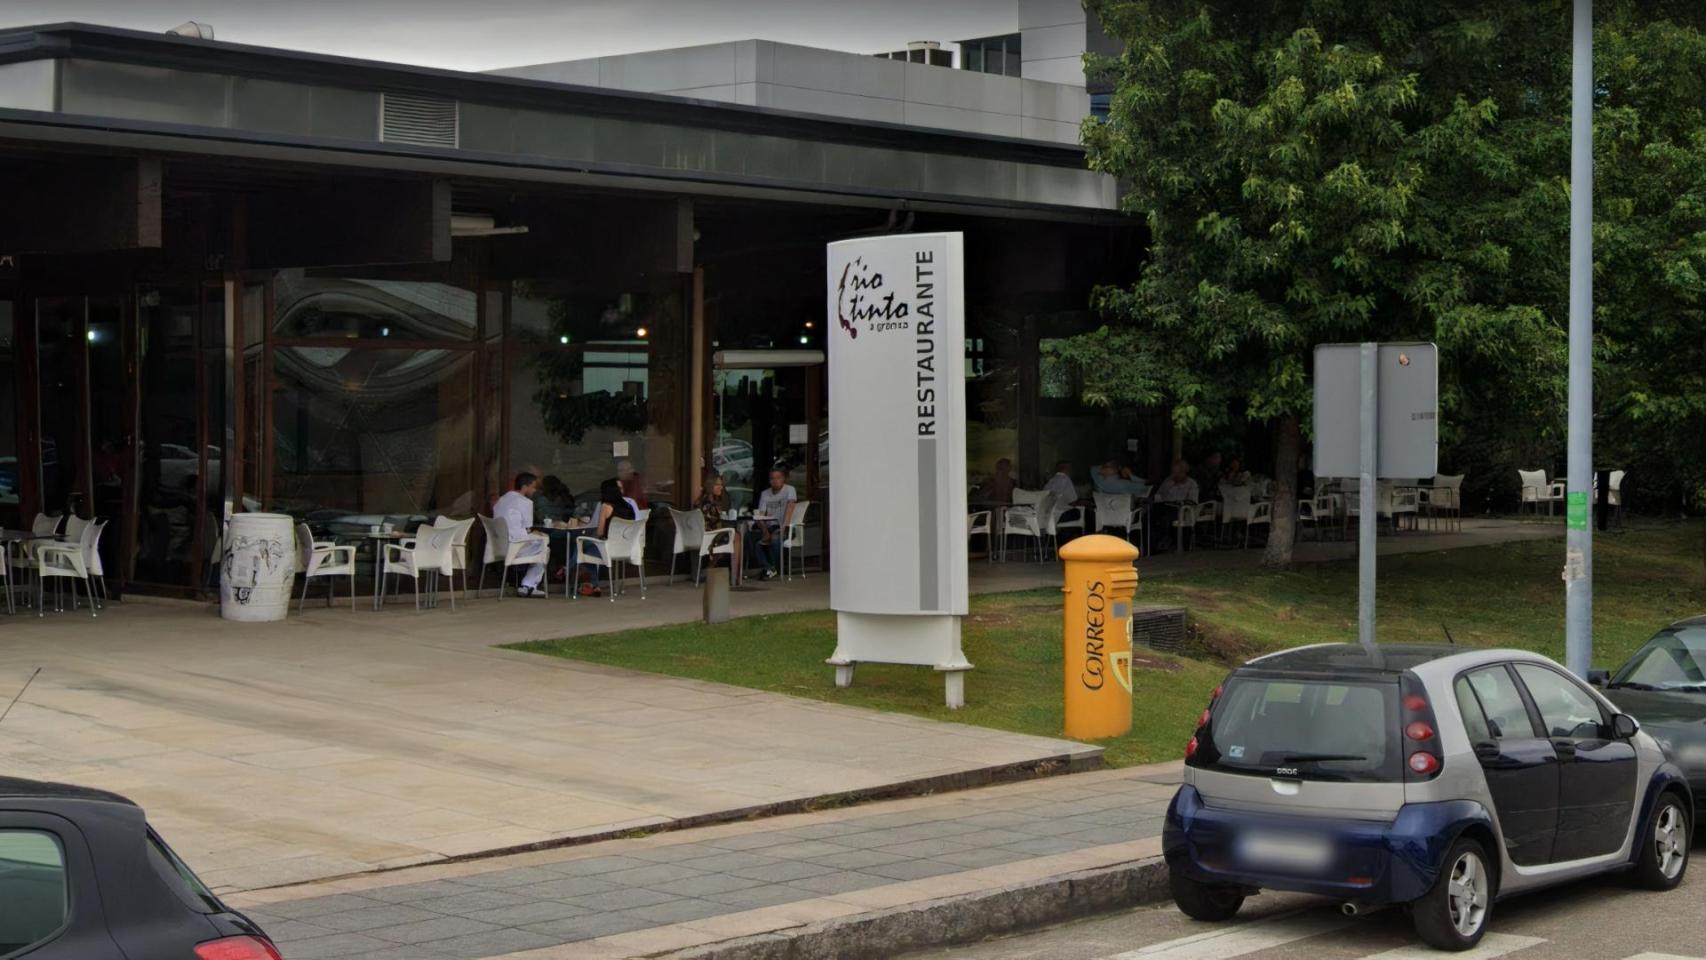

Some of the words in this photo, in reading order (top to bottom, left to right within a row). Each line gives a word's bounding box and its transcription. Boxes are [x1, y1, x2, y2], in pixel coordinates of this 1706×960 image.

[850, 291, 909, 322] tinto
[916, 251, 936, 436] RESTAURANTE
[1082, 580, 1106, 691] CORREOS
